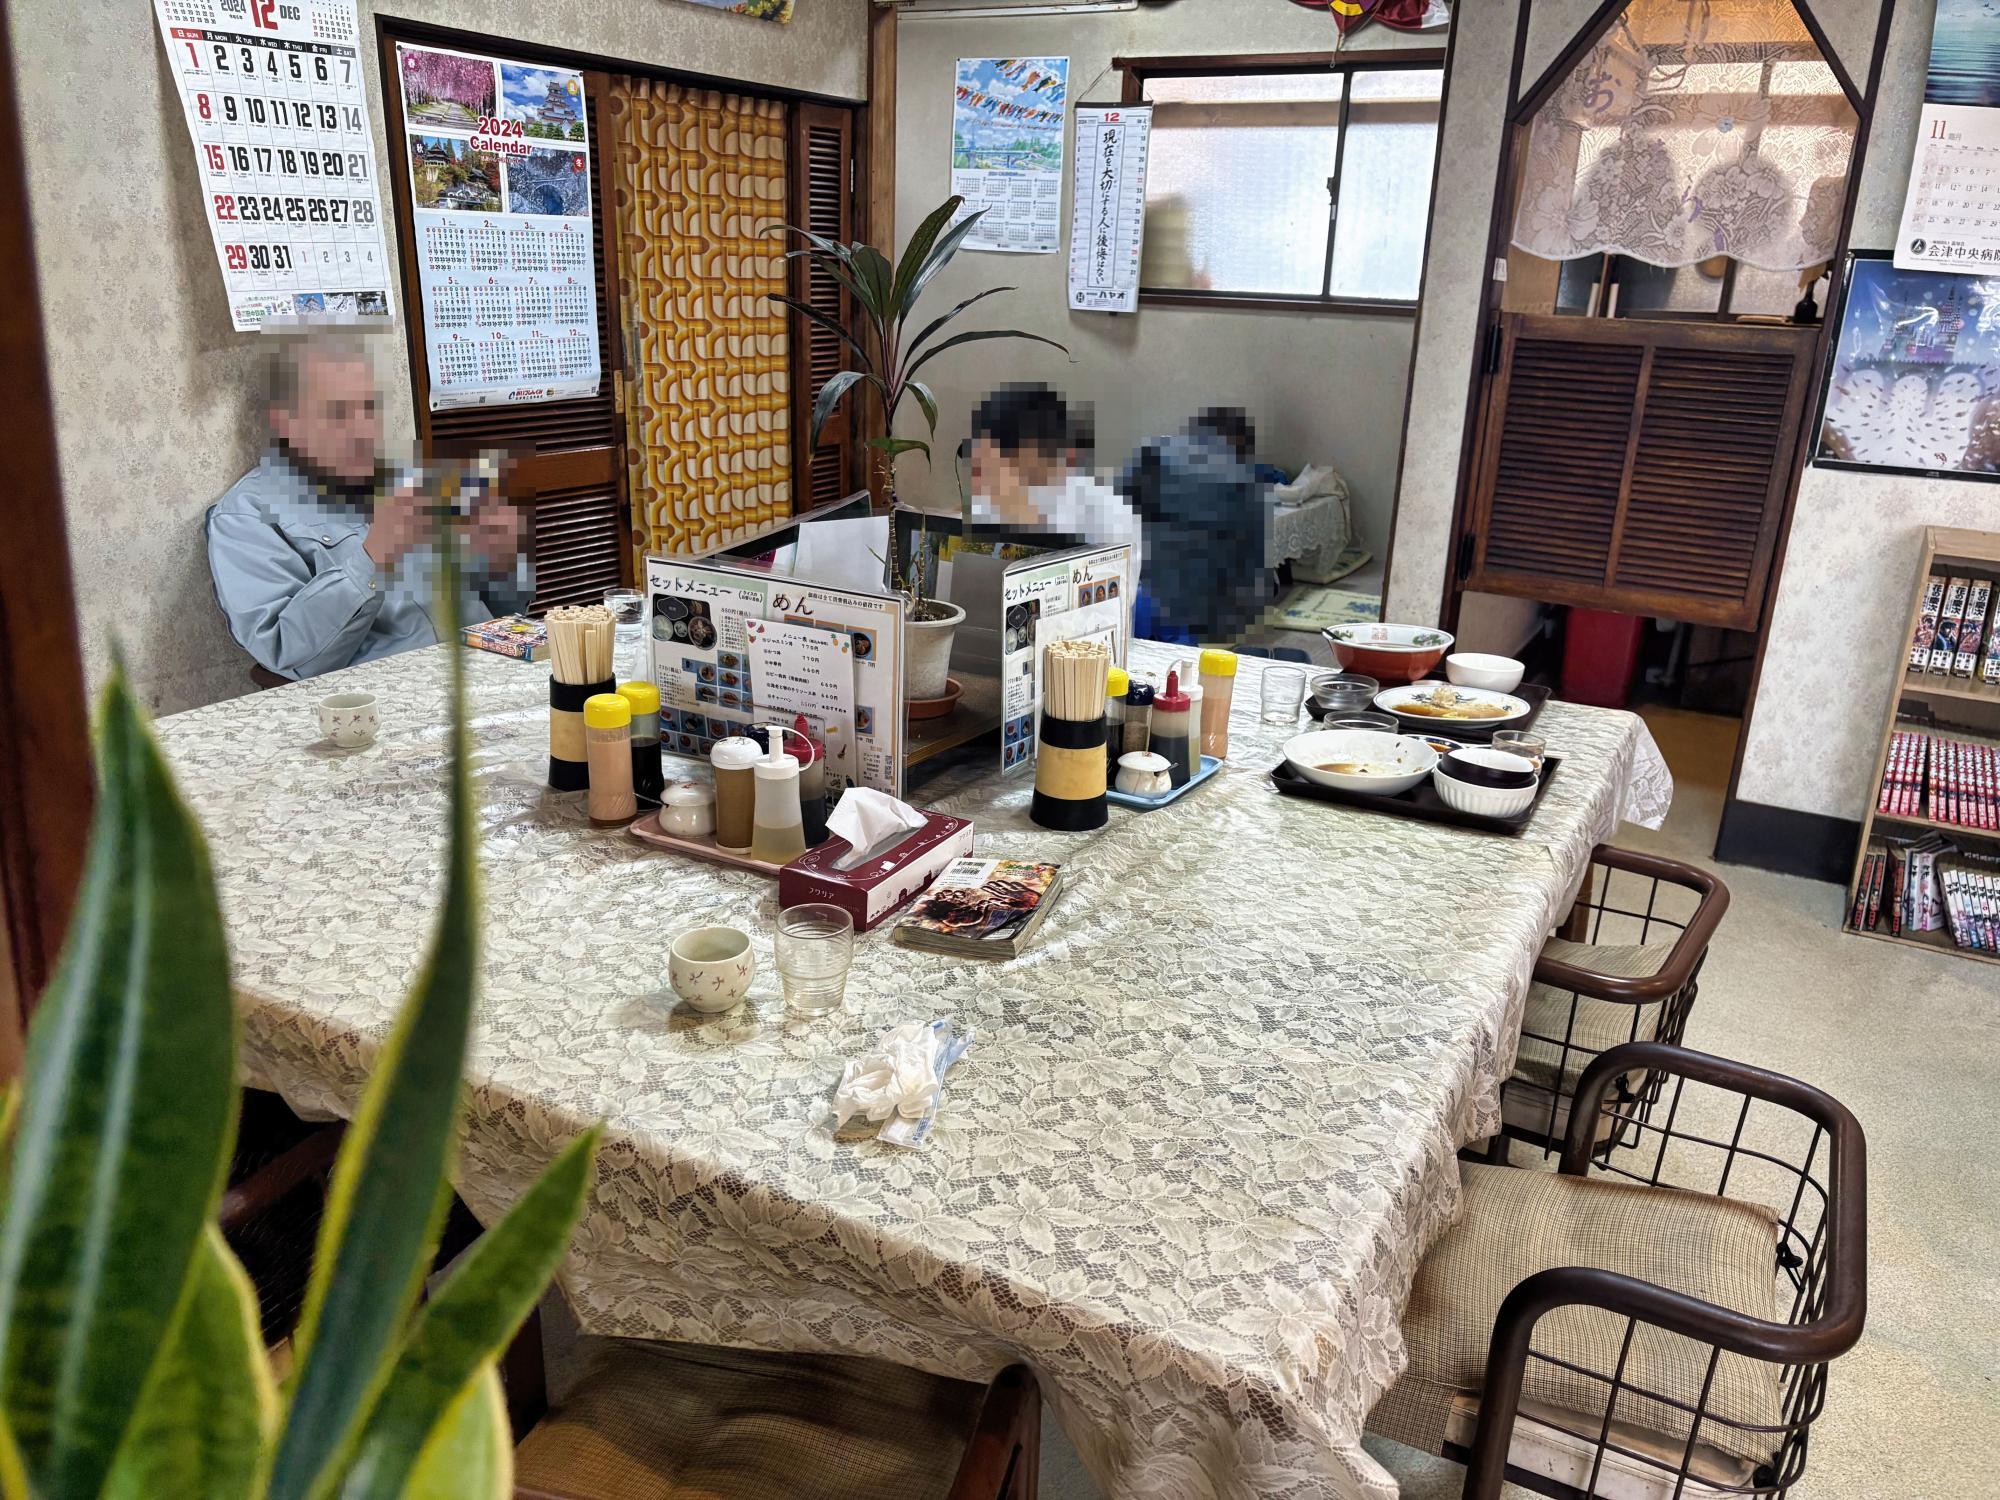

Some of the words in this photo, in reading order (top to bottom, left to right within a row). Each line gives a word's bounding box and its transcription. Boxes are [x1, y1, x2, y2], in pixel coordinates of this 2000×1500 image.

[221, 0, 247, 13] 2024
[251, 0, 278, 30] 12
[280, 5, 300, 20] DEC
[207, 32, 213, 40] 月
[236, 35, 242, 43] 火
[312, 45, 318, 53] 金
[185, 43, 200, 68] 1
[214, 45, 230, 71] 2
[241, 48, 254, 73] 3
[268, 51, 278, 76] 4
[288, 54, 302, 78] 5
[315, 57, 328, 81] 6
[340, 60, 351, 83] 7
[197, 94, 212, 119] 8
[224, 96, 237, 121] 9
[245, 98, 266, 124] 10
[271, 100, 289, 126] 11
[293, 102, 312, 128] 12
[317, 105, 337, 130] 13
[343, 106, 362, 131] 14
[1104, 112, 1120, 122] 12
[478, 117, 523, 138] 2024
[1931, 120, 1946, 139] 11
[470, 136, 532, 155] Calendar
[204, 144, 224, 170] 15
[228, 146, 250, 172] 16
[254, 148, 272, 173] 17
[278, 149, 298, 174] 18
[301, 151, 319, 175] 19
[322, 152, 344, 176] 20
[348, 154, 368, 178] 21
[214, 195, 238, 220] 22
[238, 196, 261, 220] 23
[262, 197, 283, 221] 24
[285, 198, 307, 222] 25
[308, 199, 329, 222] 26
[330, 200, 349, 223] 27
[353, 200, 374, 223] 28
[225, 245, 248, 269] 29
[249, 245, 271, 269] 30
[273, 246, 292, 269] 31
[302, 251, 307, 263] 1
[323, 251, 330, 263] 2
[345, 251, 351, 263] 3
[367, 251, 373, 263] 4
[650, 575, 733, 596] セットメニュー
[1072, 566, 1093, 584] めん
[1004, 580, 1052, 601] セットメニュー
[772, 594, 814, 616] めん
